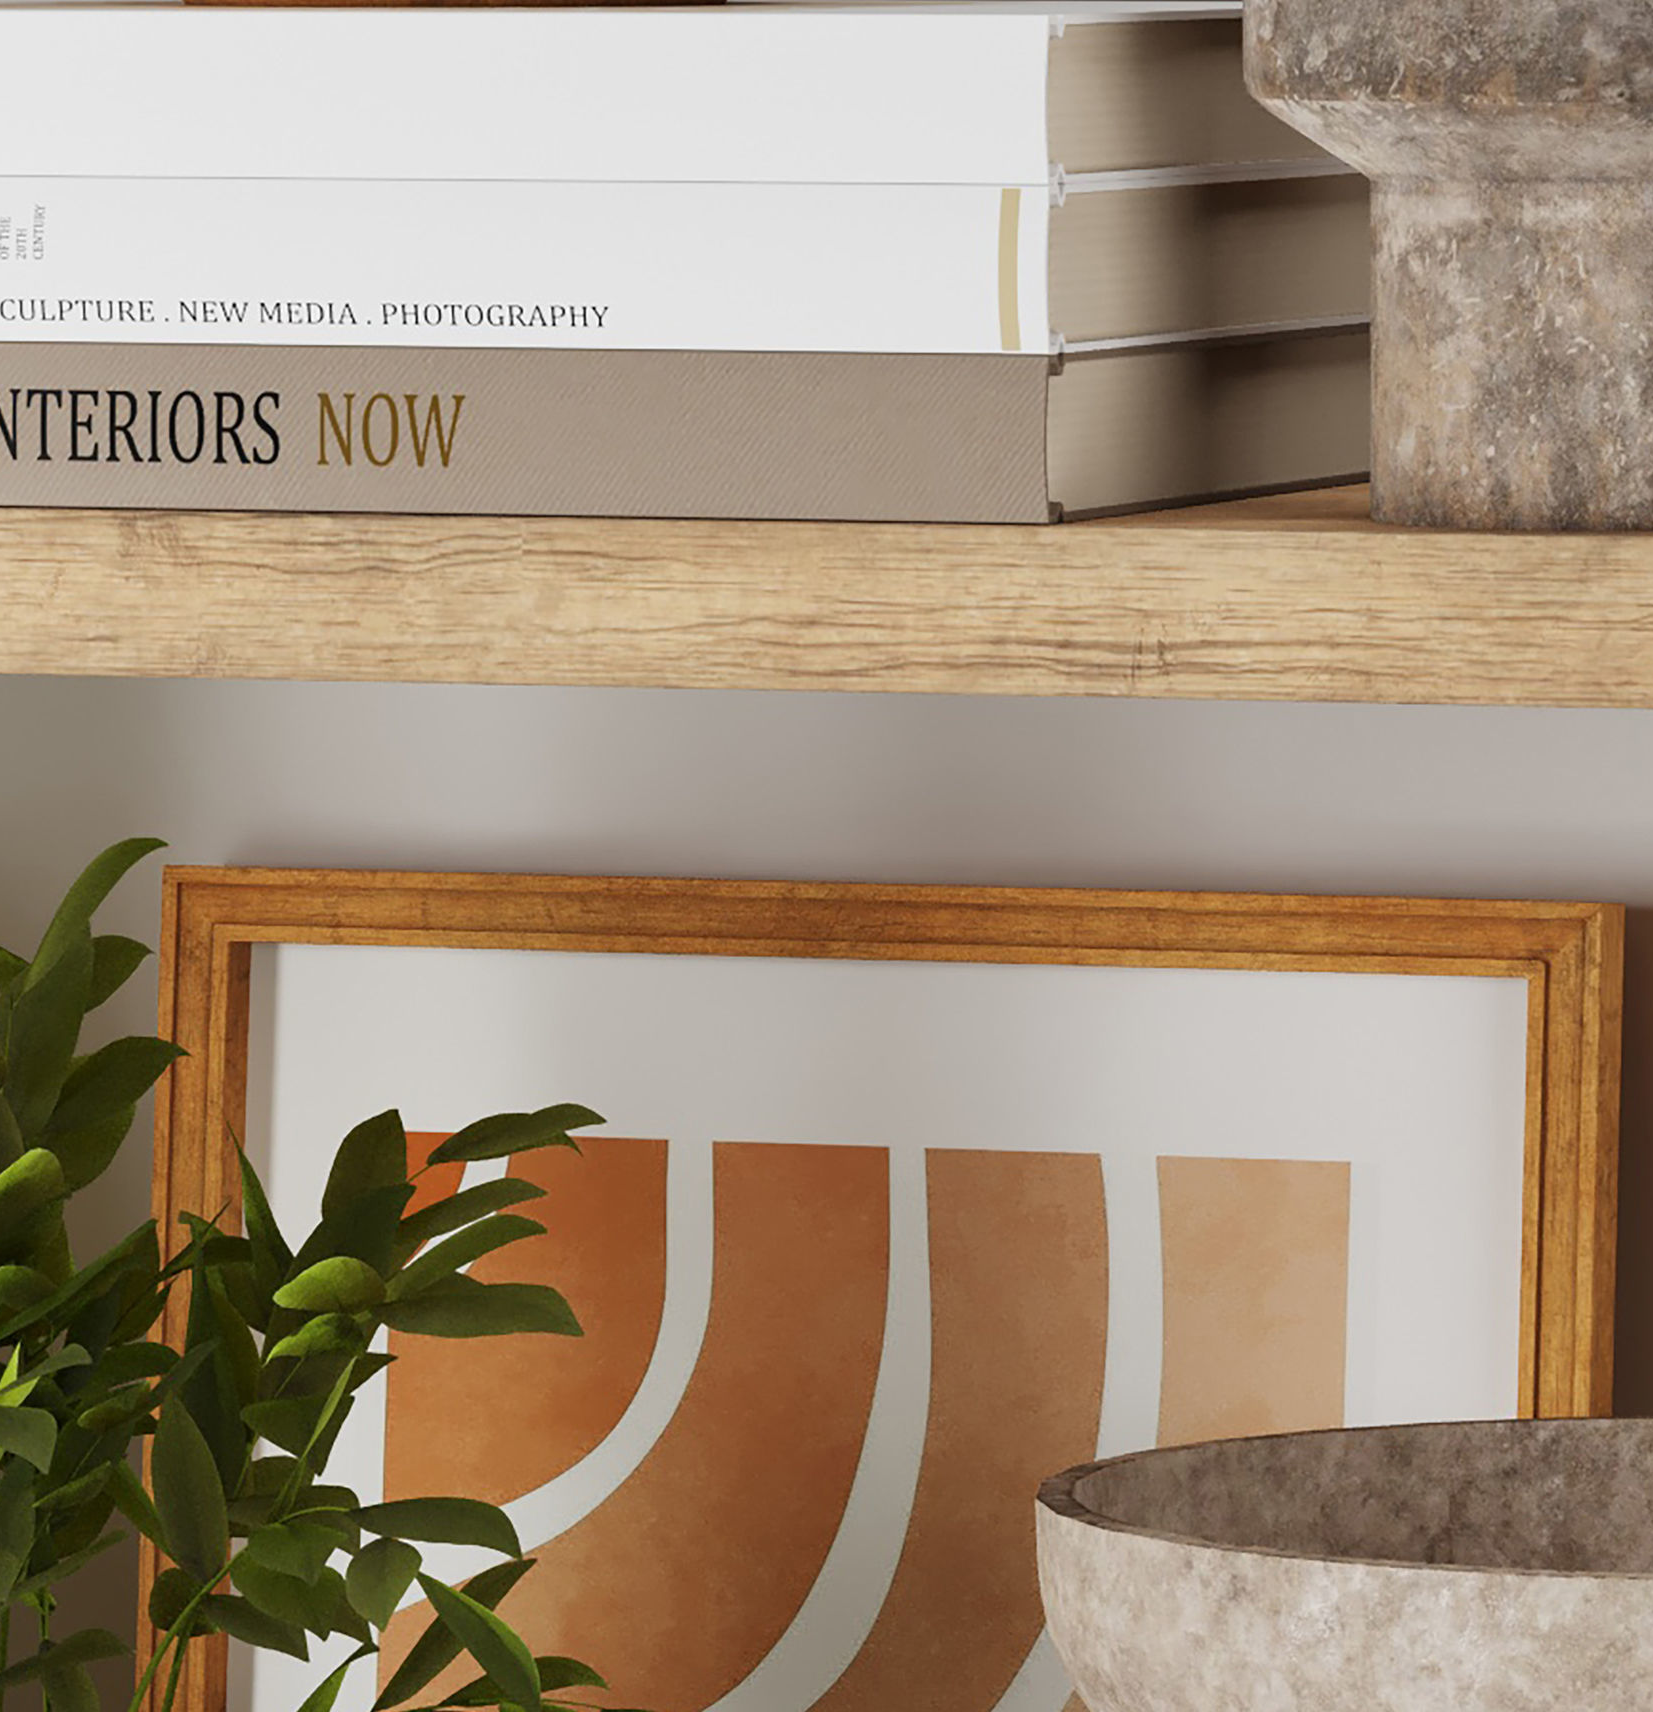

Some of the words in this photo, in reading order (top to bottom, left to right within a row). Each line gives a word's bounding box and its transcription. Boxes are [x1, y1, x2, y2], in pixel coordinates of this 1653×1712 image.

[15, 228, 28, 260] 20TH
[32, 204, 46, 260] CENTURY
[179, 300, 249, 324] NEW
[259, 301, 358, 326] MEDIA
[381, 302, 609, 328] PHOTOGRAPHY
[316, 391, 467, 469] NOW
